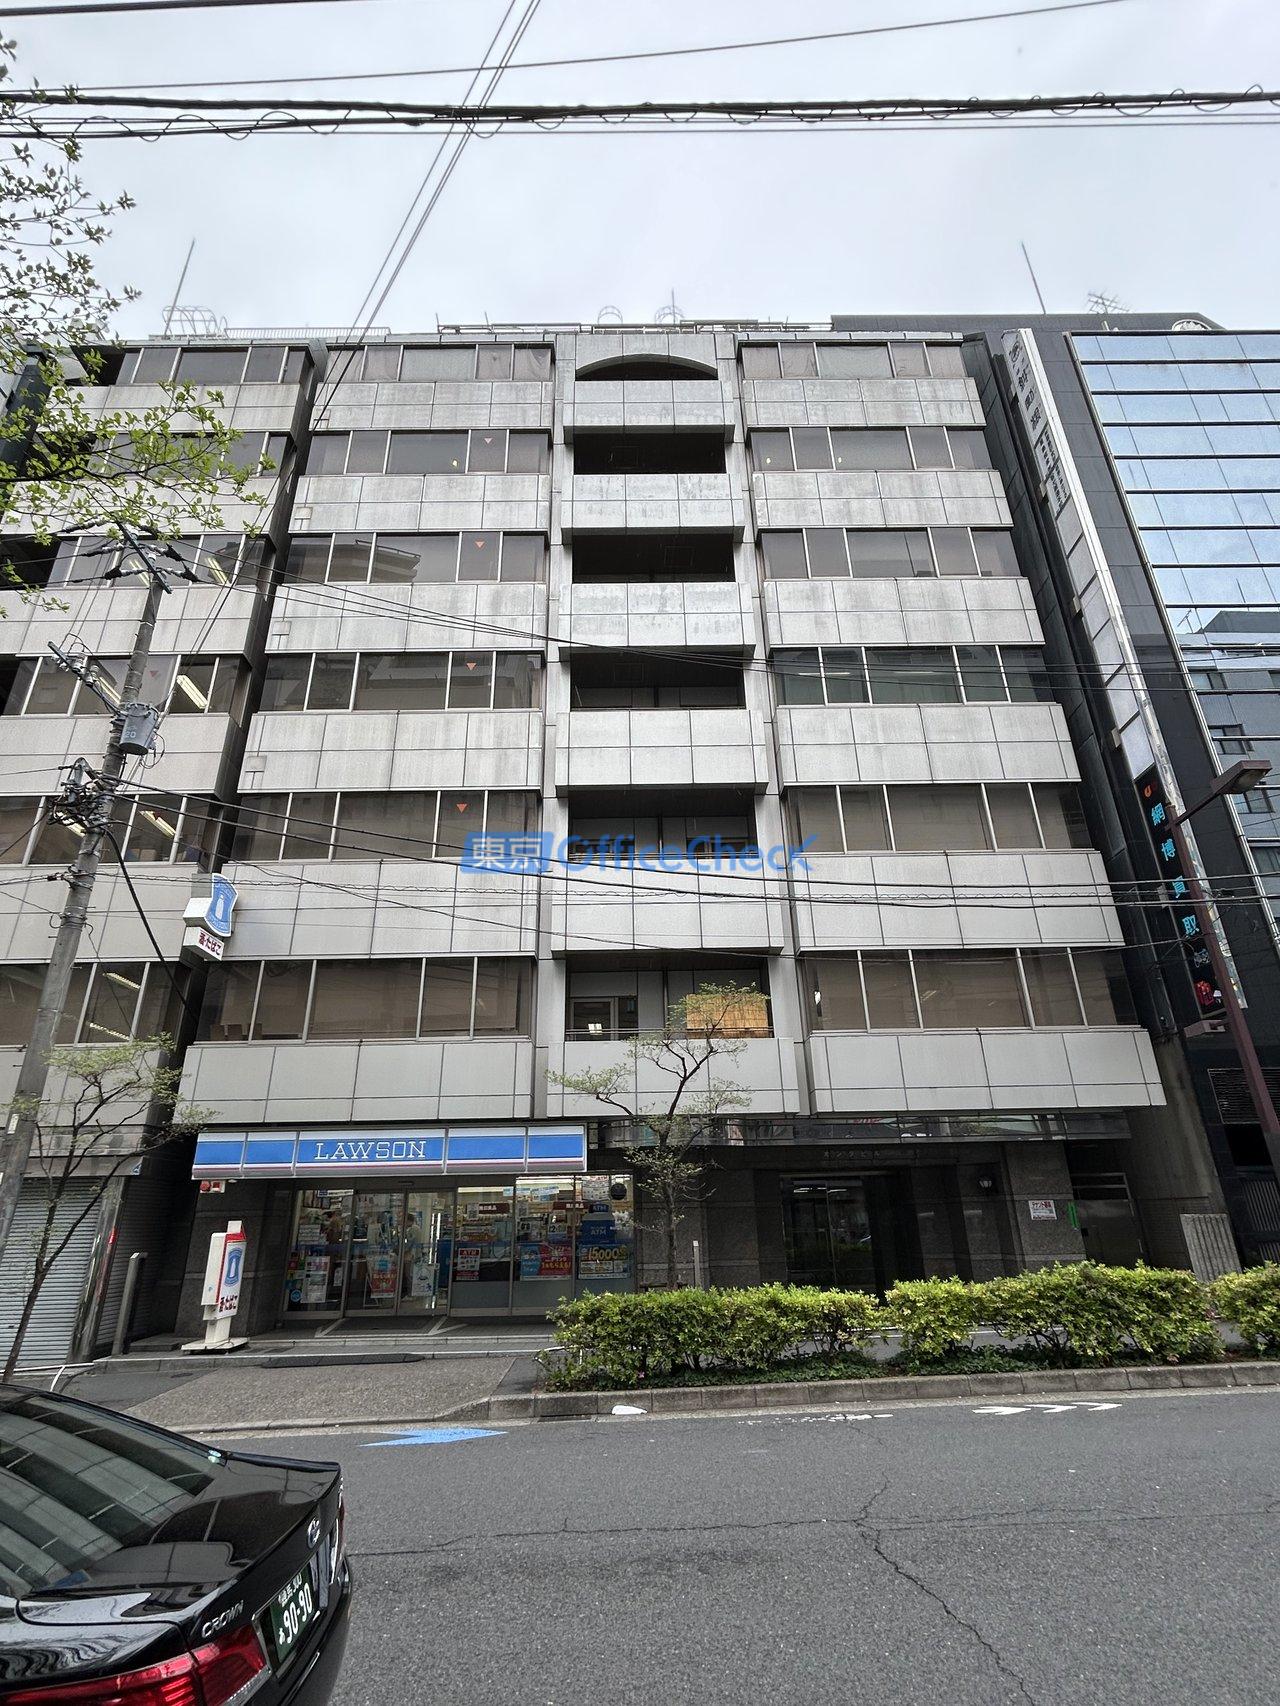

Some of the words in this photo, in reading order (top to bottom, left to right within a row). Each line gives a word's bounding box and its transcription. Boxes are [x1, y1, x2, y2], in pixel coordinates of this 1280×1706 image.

[314, 1140, 427, 1160] LAWSON
[202, 1599, 244, 1638] CROWN
[283, 1582, 313, 1644] 90-90
